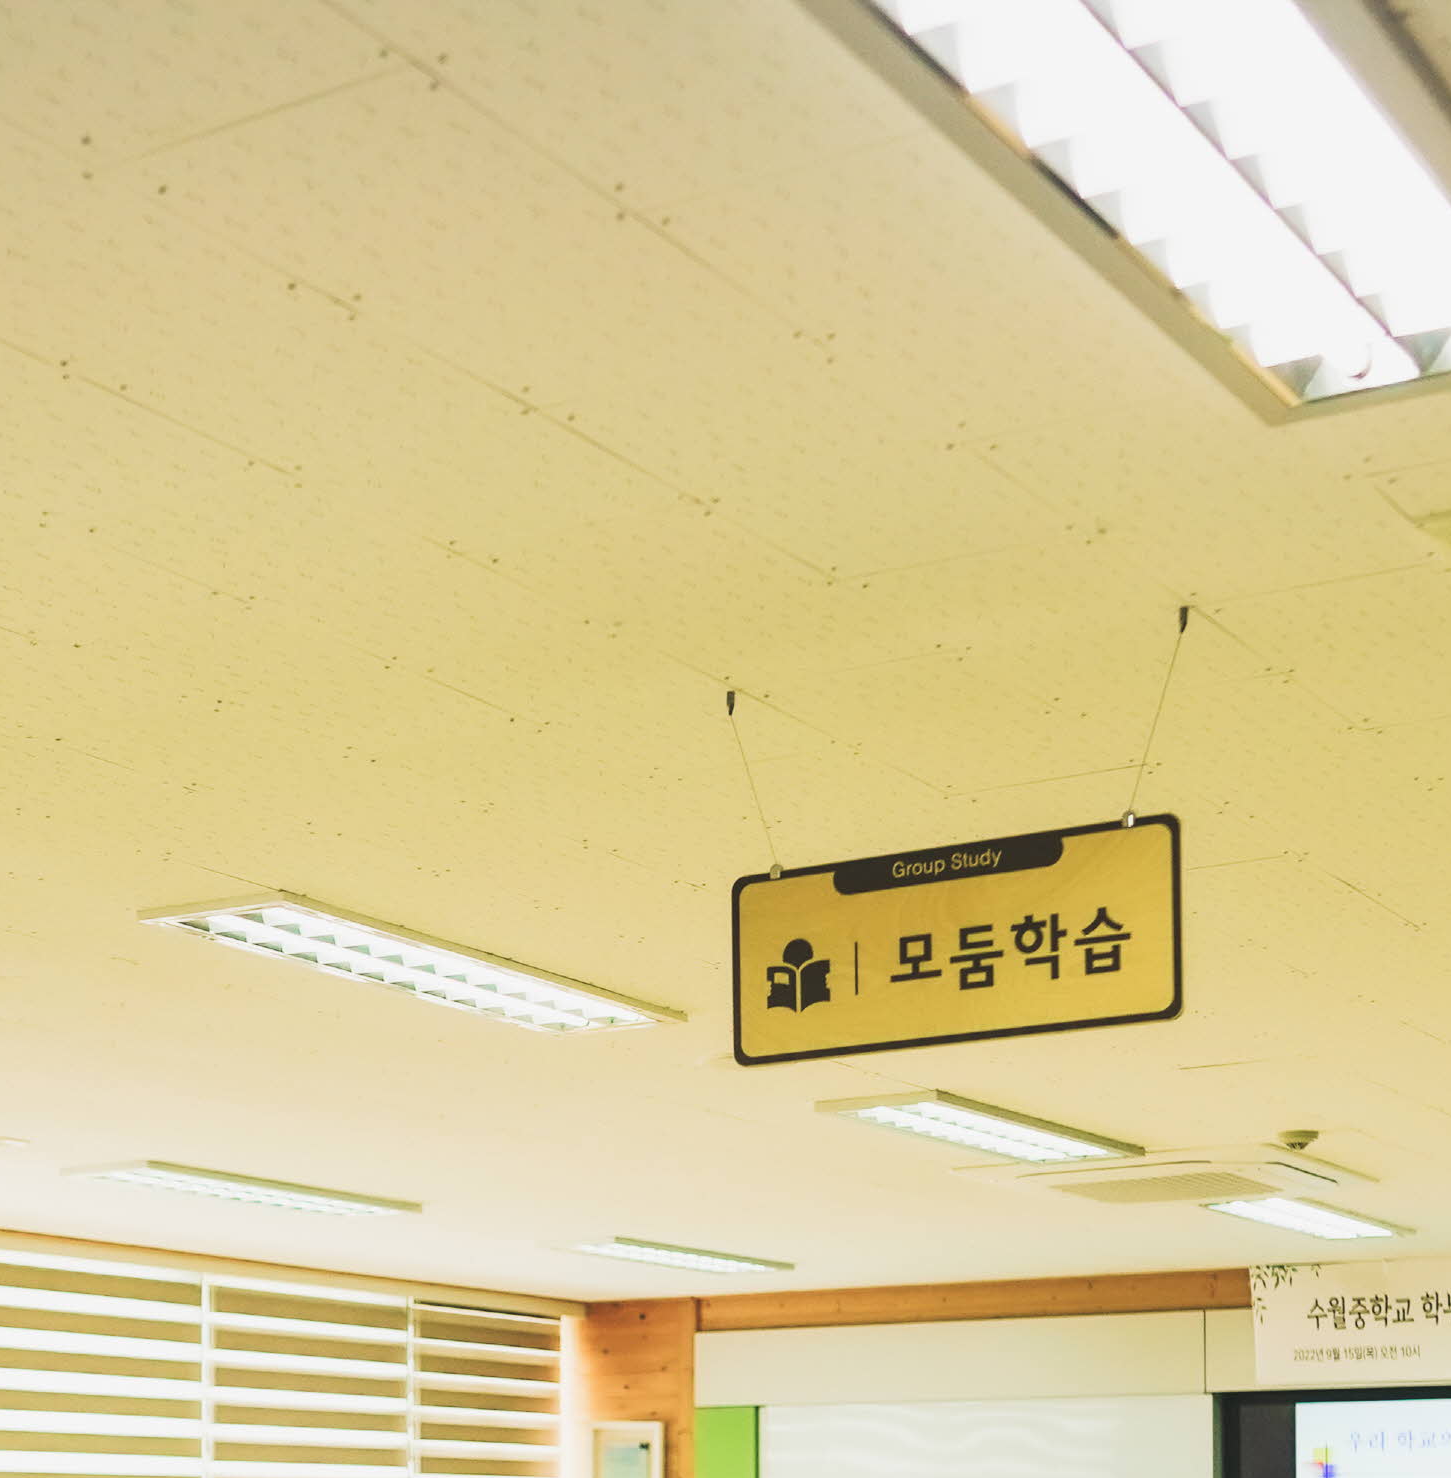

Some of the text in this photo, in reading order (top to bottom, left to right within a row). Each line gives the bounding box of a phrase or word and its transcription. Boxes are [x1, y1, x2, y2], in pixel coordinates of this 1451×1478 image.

[892, 848, 1002, 879] Group Study
[890, 907, 1131, 990] 모둠학습
[1307, 1292, 1415, 1331] 수월중학교
[1294, 1348, 1325, 1362] 2022년
[1401, 1344, 1421, 1358] 10시
